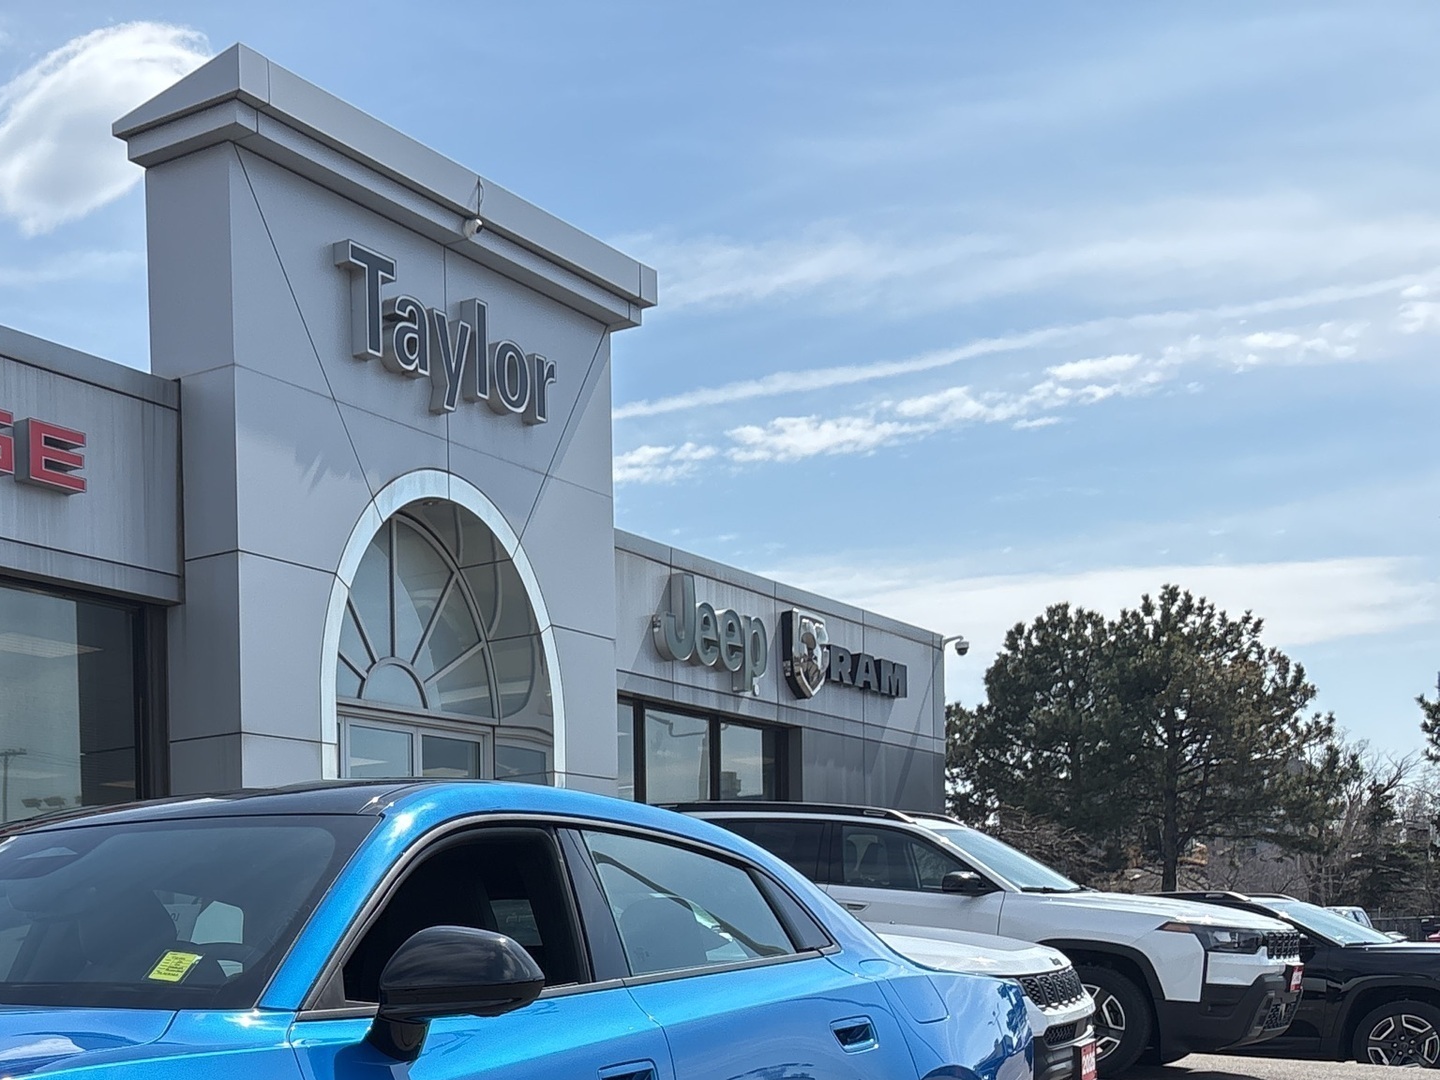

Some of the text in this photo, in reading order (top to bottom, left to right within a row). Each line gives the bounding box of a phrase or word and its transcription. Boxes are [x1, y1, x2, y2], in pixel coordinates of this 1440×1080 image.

[334, 240, 557, 425] Taylor
[653, 573, 768, 692] Jeep
[829, 645, 908, 698] RAM
